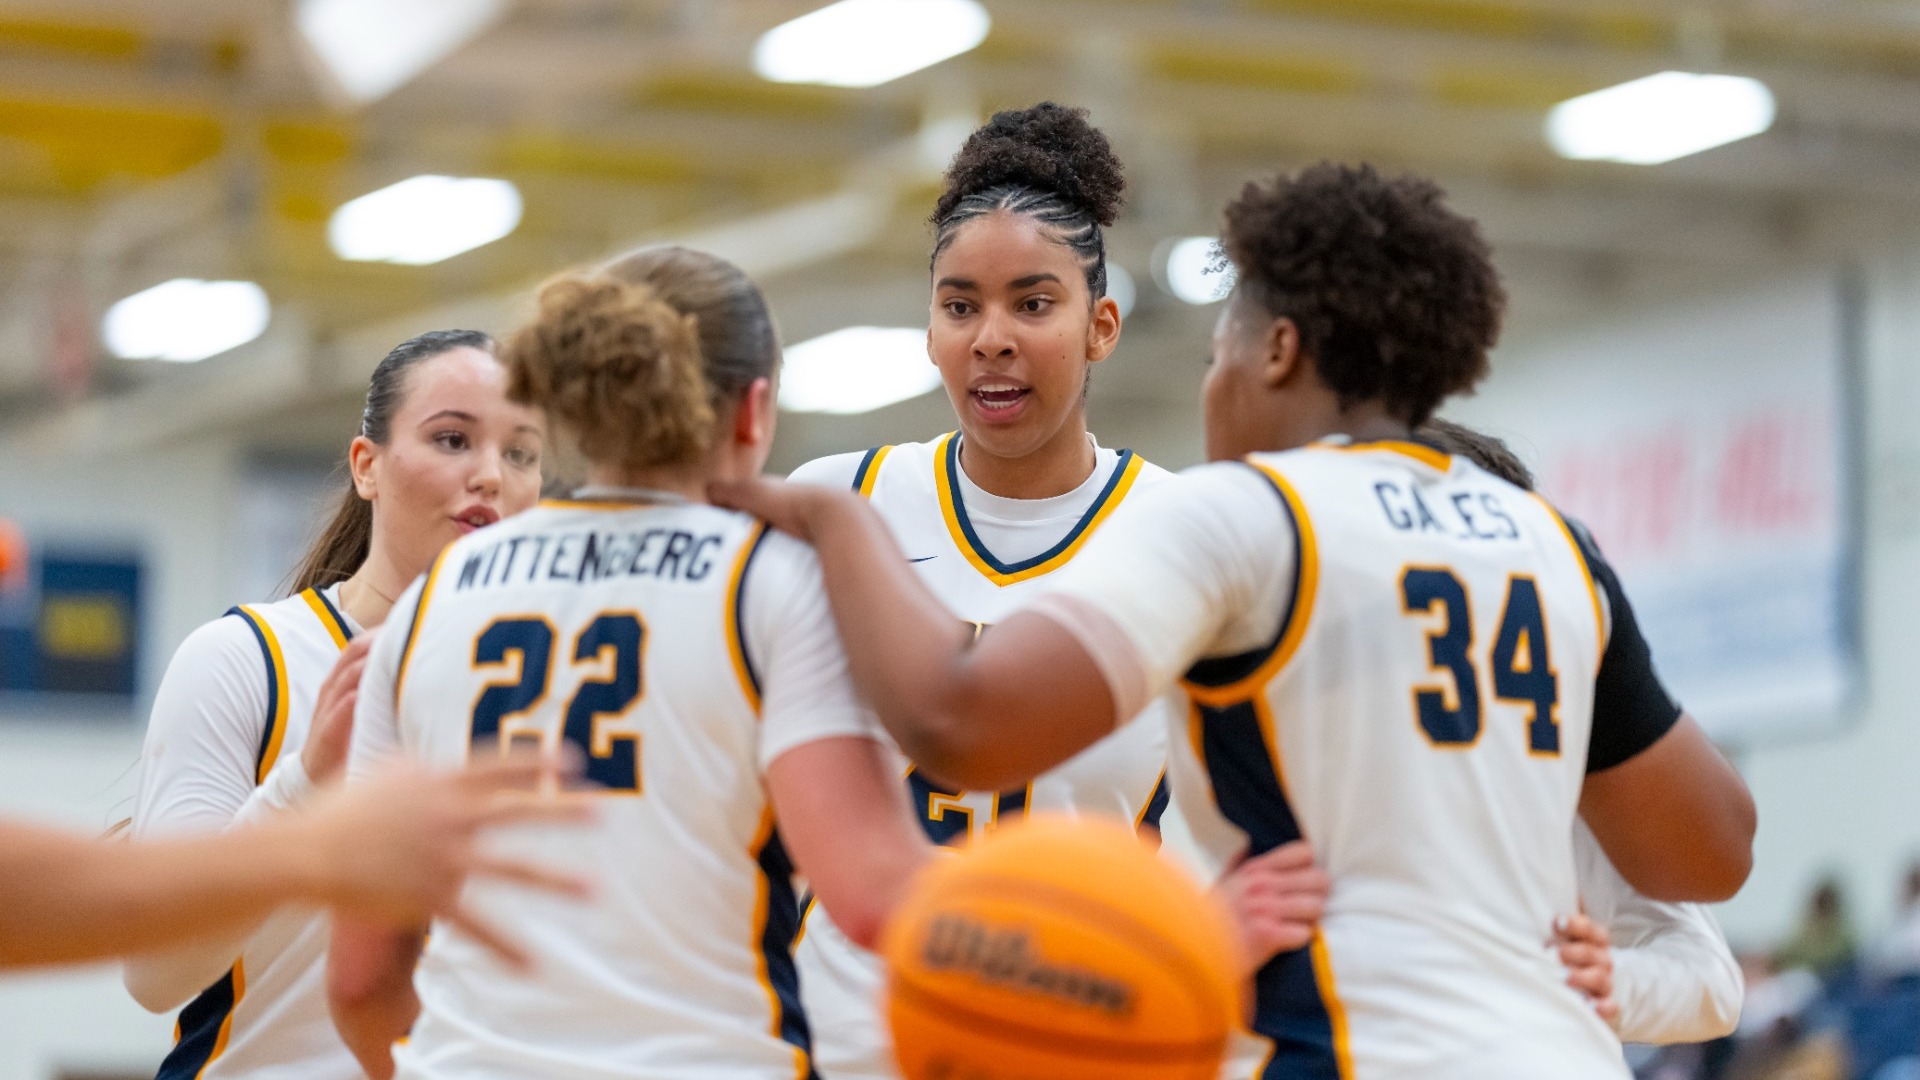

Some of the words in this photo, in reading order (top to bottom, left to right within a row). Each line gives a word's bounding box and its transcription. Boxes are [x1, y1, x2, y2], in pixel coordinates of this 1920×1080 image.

[1374, 481, 1520, 540] GAES
[470, 610, 646, 795] 22
[1397, 563, 1561, 758] 34
